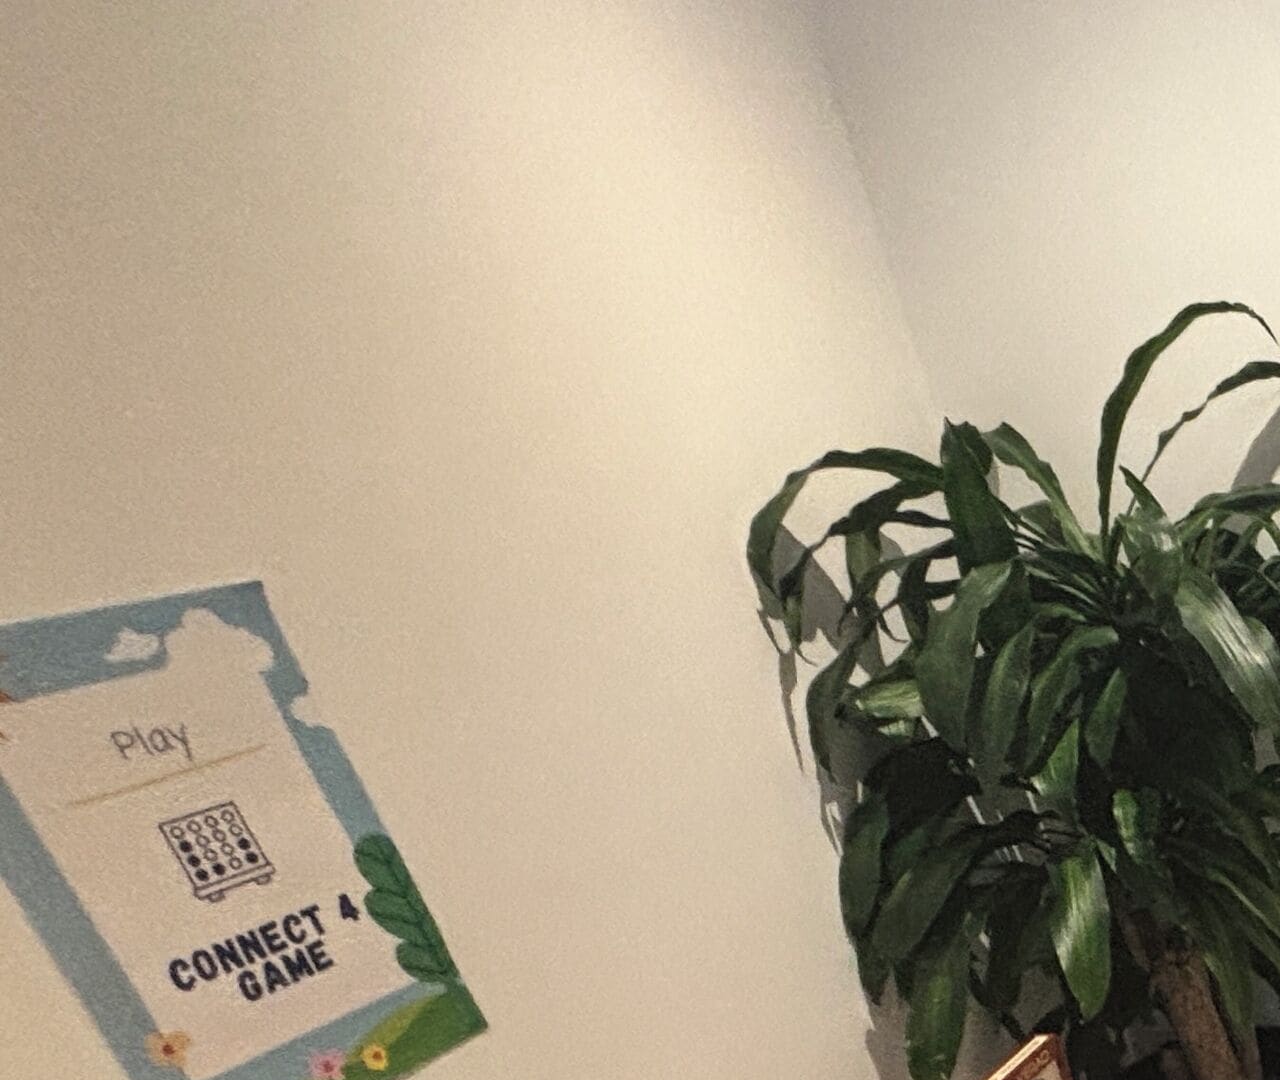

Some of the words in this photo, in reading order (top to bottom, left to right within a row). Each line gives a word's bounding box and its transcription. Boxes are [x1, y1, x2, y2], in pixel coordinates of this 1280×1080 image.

[110, 723, 193, 760] Play
[169, 905, 325, 992] CONNECT
[338, 894, 361, 922] 4
[237, 942, 334, 1001] GAME
